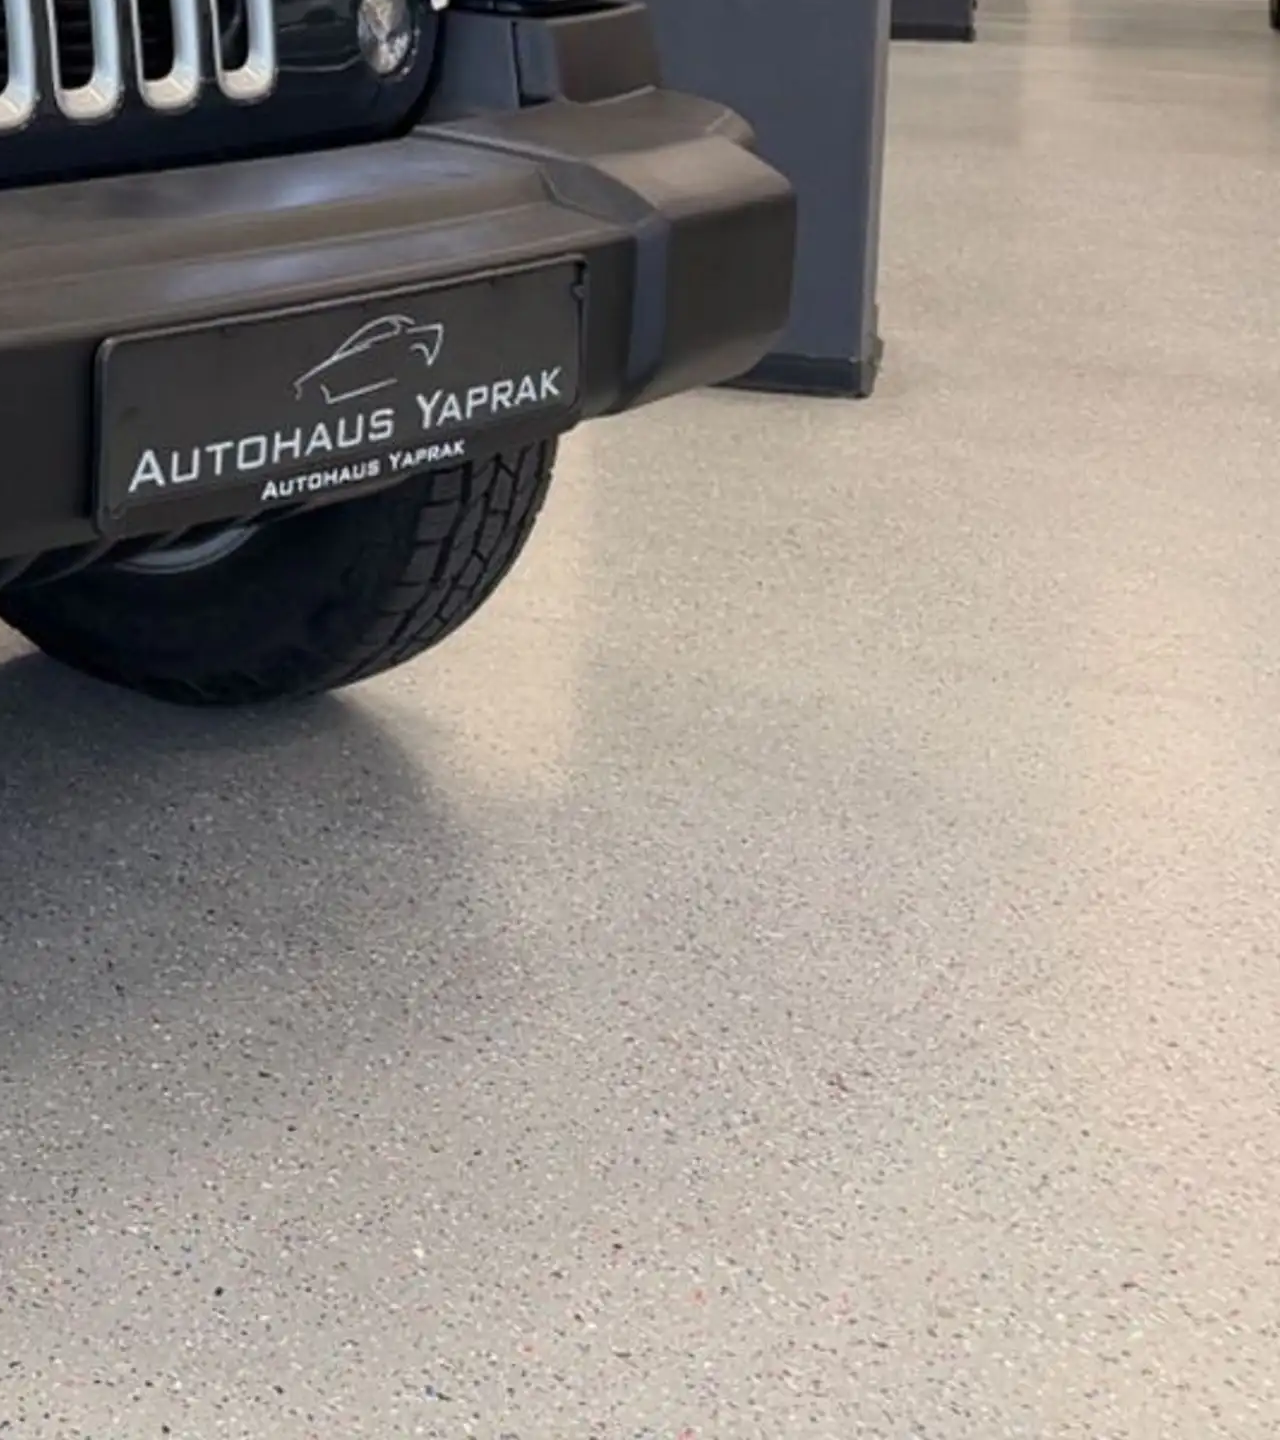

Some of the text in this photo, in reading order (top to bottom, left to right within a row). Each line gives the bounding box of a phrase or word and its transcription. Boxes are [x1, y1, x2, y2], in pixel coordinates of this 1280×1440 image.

[127, 365, 562, 493] AUTOHAUS YAPRAK
[260, 439, 466, 501] AUTOHAUS YAPRAK
